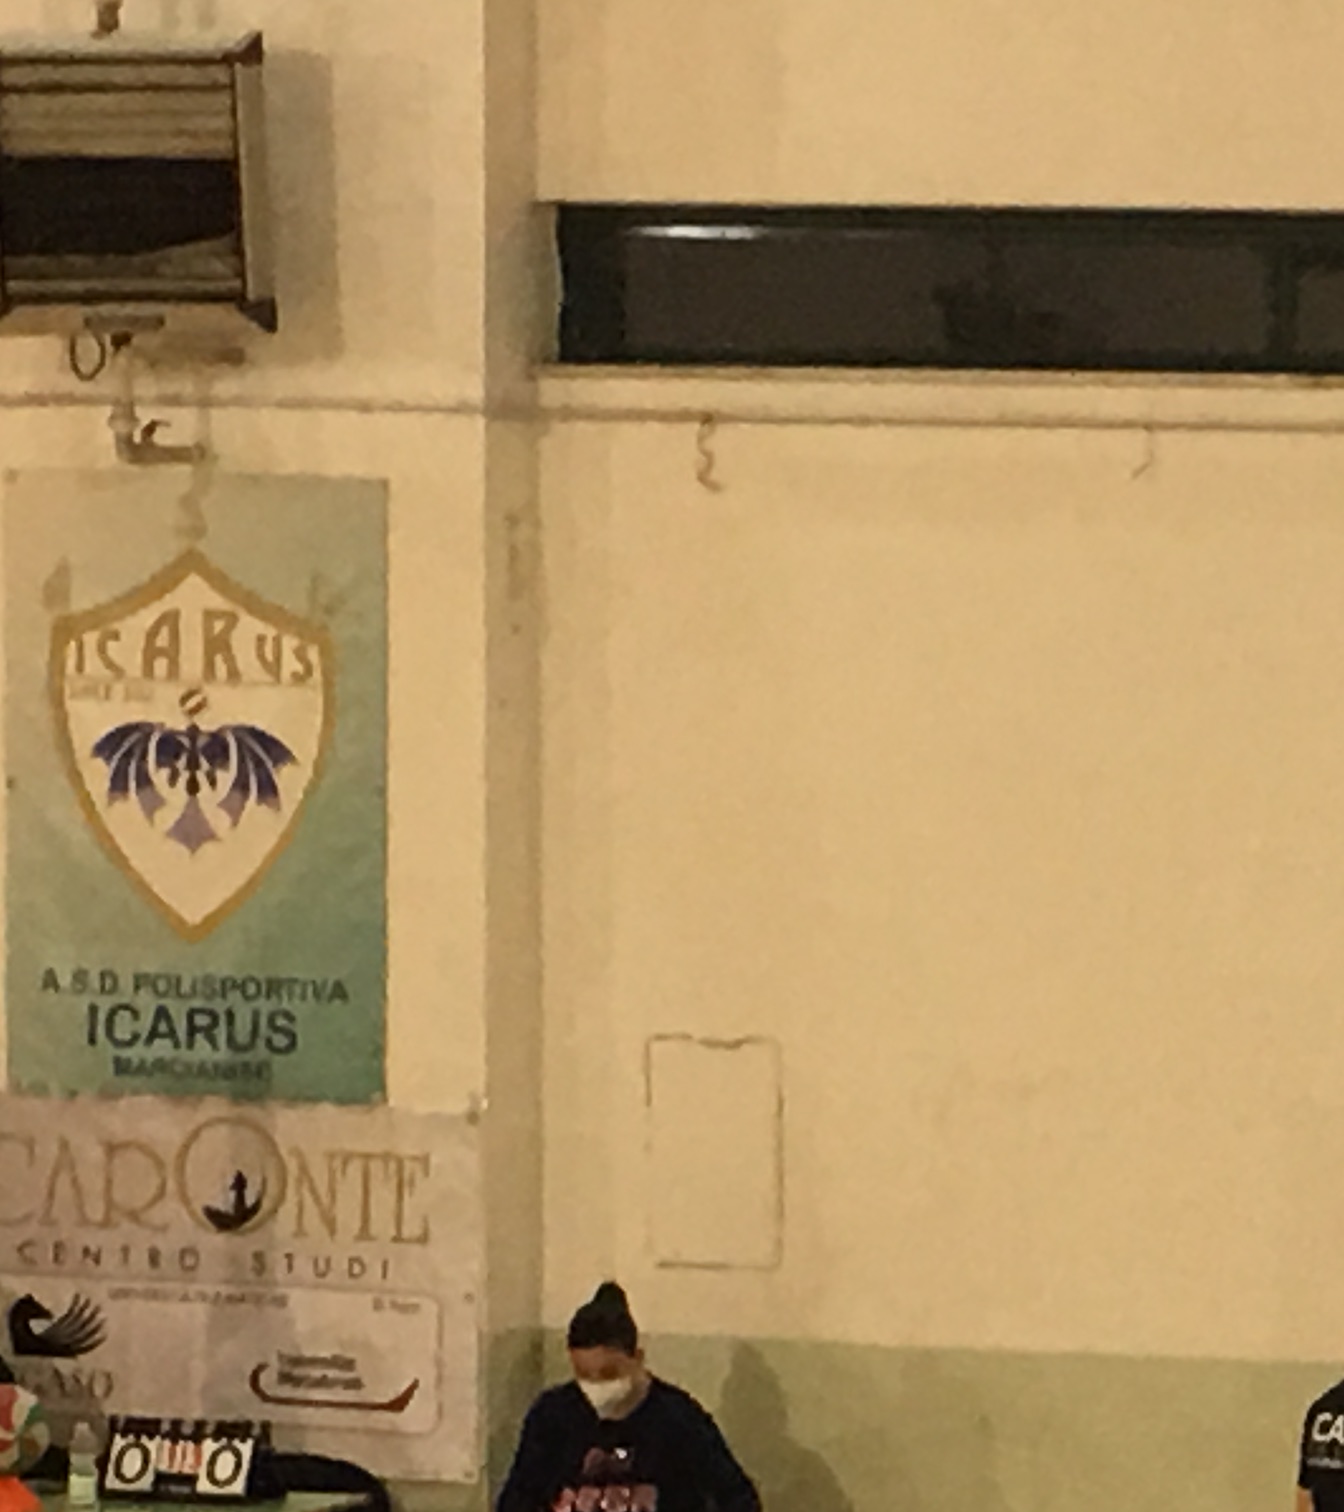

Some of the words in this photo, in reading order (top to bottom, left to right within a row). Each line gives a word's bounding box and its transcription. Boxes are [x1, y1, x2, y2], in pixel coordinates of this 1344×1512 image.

[75, 608, 314, 683] ICARUS
[133, 972, 350, 1004] POLISPORTIVA
[86, 1003, 298, 1055] ICARUS
[16, 1240, 200, 1272] CENTRO
[250, 1251, 390, 1281] STUDI
